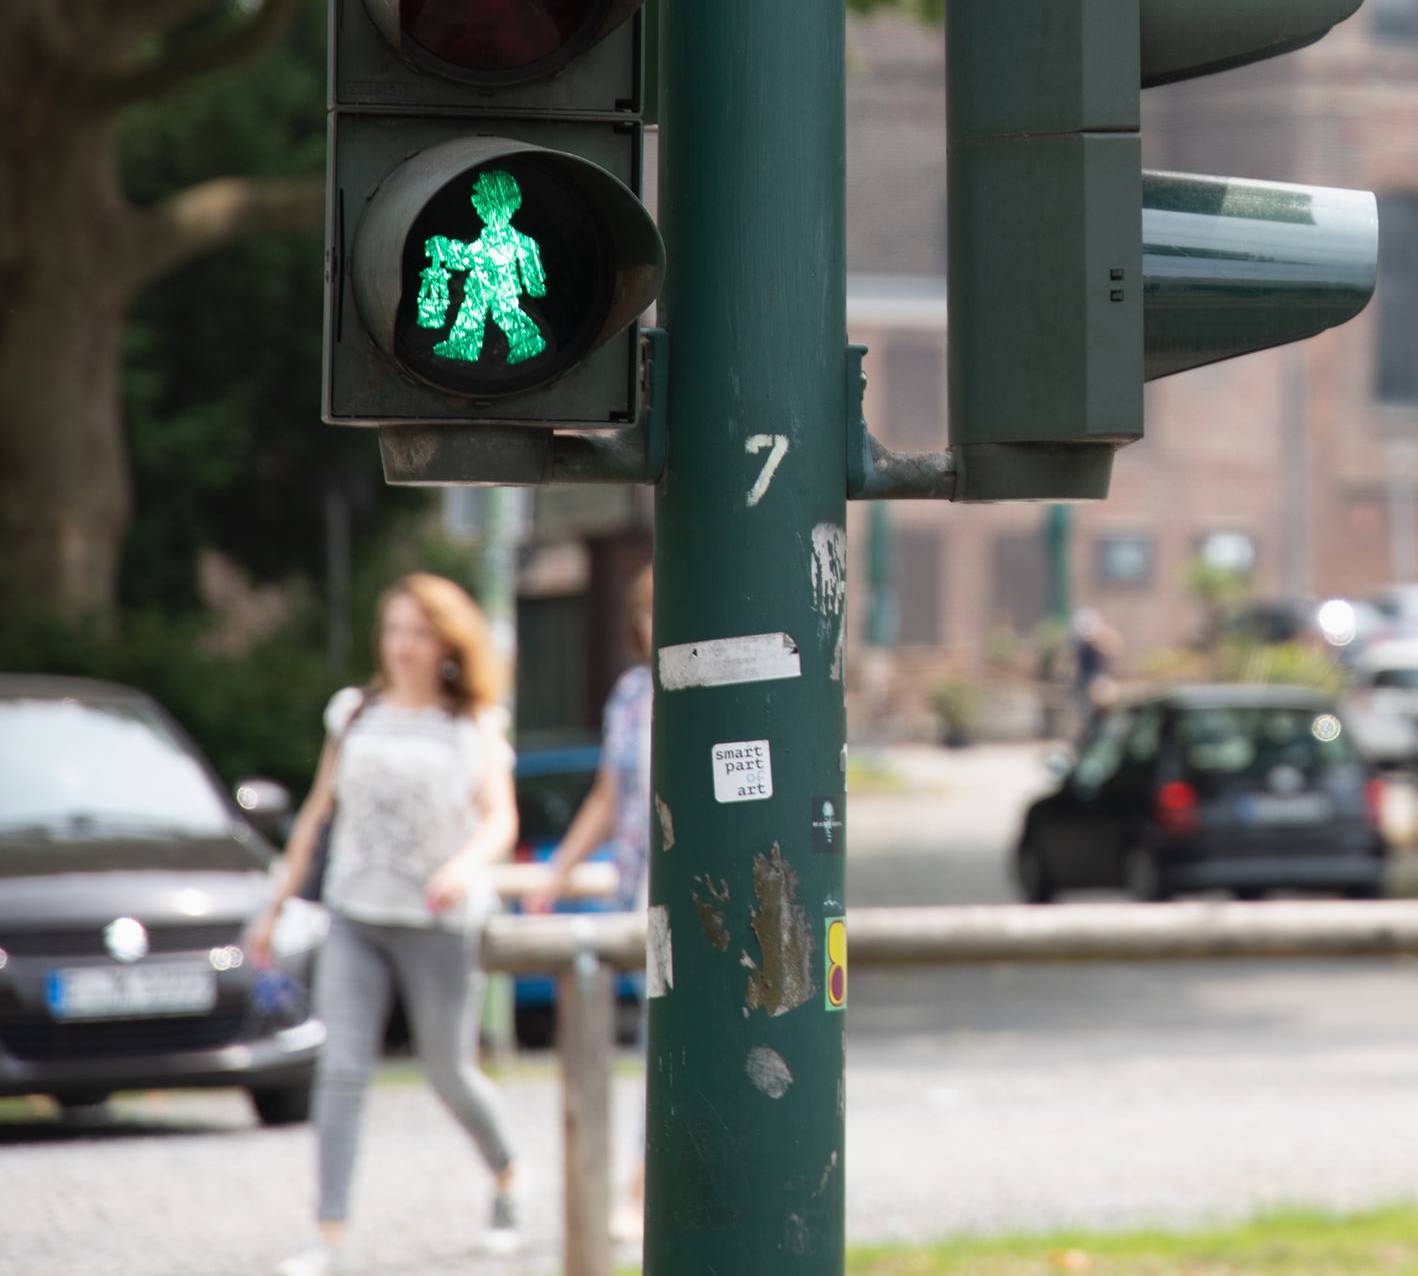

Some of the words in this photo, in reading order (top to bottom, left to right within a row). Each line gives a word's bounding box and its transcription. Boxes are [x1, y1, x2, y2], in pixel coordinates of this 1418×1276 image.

[745, 434, 789, 507] 7
[716, 746, 763, 760] smart
[725, 758, 764, 775] part
[746, 770, 767, 782] of
[737, 784, 766, 796] art
